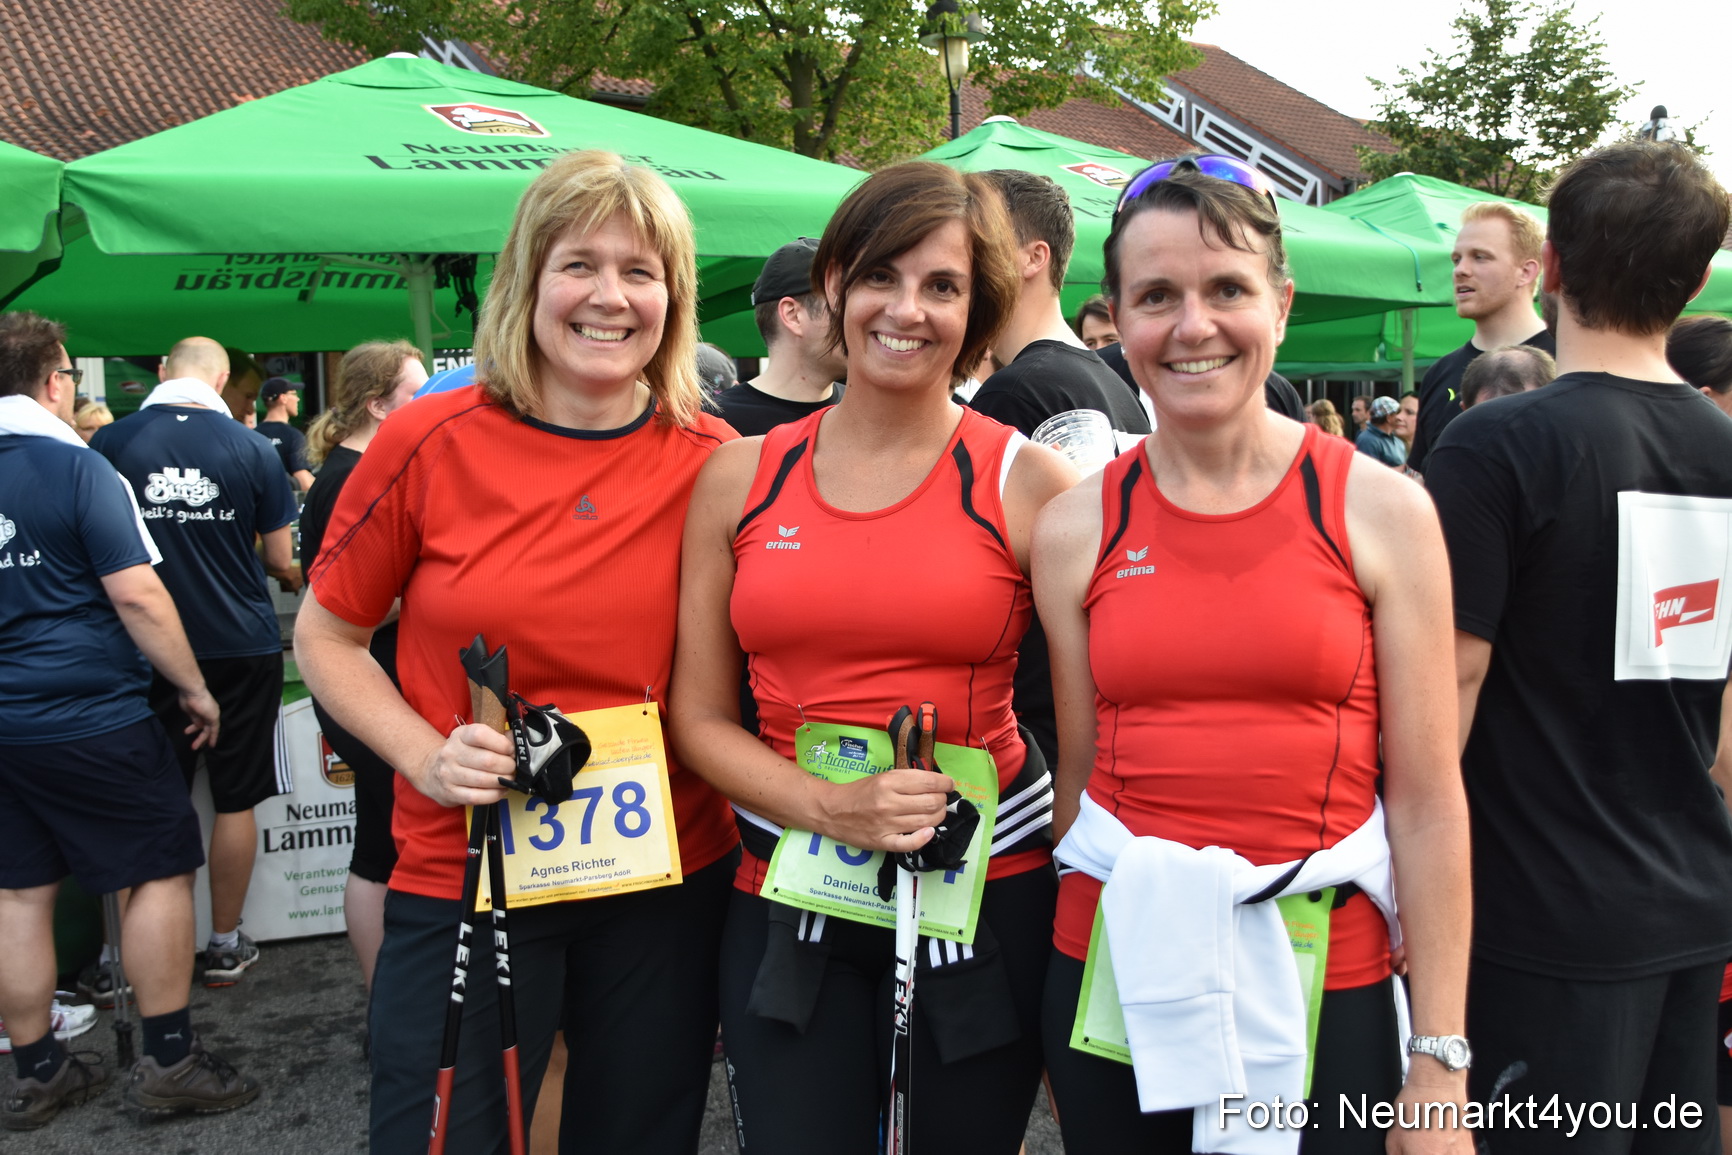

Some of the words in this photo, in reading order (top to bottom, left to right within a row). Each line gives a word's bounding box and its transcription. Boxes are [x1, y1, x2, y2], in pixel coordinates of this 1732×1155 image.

[145, 473, 220, 507] Burgis
[765, 539, 801, 551] erima
[1116, 564, 1156, 579] erima
[514, 728, 528, 761] LEKI
[286, 799, 358, 822] Neuma
[500, 780, 653, 856] 1378
[263, 823, 357, 854] Lamm
[530, 861, 570, 879] Agnes
[572, 855, 617, 873] Richter
[518, 880, 551, 892] Sparkasse
[551, 871, 613, 888] Neumarkt-Parsberg
[809, 887, 843, 901] Sparkasse
[822, 874, 871, 896] Daniela
[491, 908, 511, 986] LEKI
[451, 921, 474, 1003] LEKI
[894, 955, 909, 1036] LEKI
